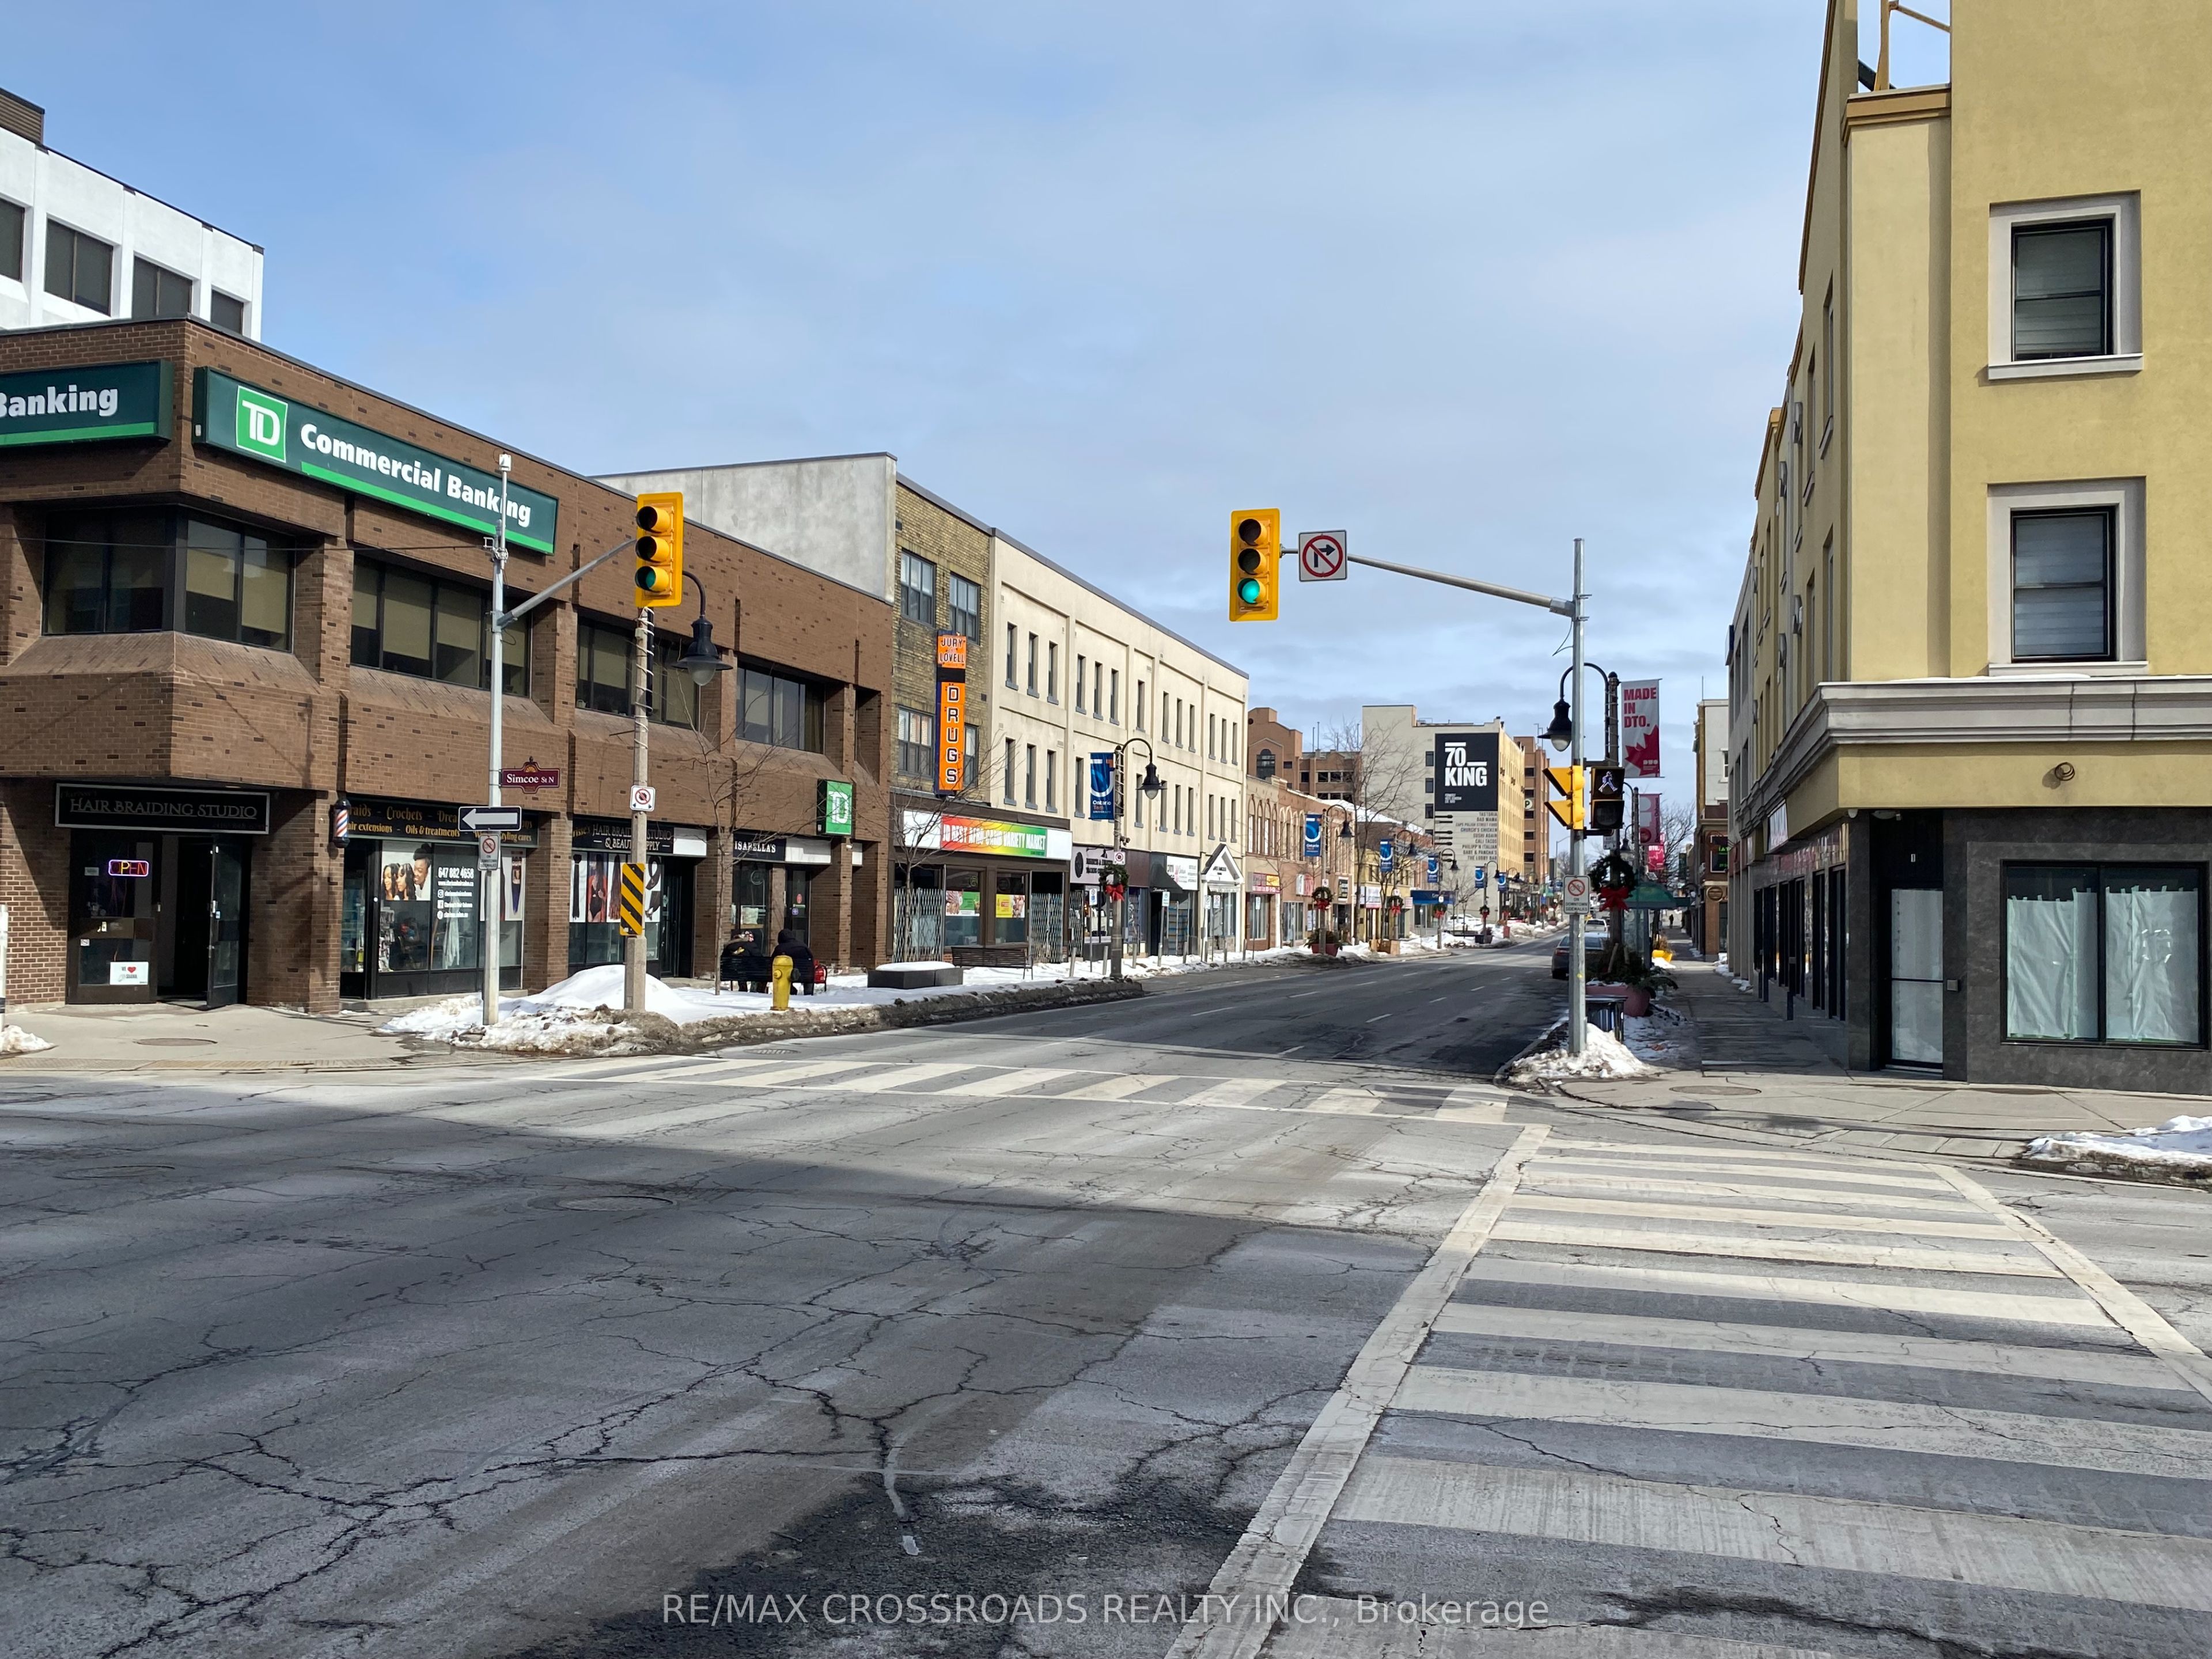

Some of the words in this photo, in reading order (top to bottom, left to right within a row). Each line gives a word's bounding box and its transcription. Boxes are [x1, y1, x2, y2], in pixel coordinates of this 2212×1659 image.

[242, 400, 281, 447] TD
[300, 423, 441, 493] Commercial
[941, 638, 963, 647] JURY
[940, 652, 964, 662] LOVELL
[1624, 687, 1657, 701] MADE
[1624, 702, 1635, 714] IN
[1624, 715, 1650, 728] DTO.
[946, 686, 959, 784] DRUGS
[1445, 747, 1466, 767] 70
[507, 774, 539, 783] Simcoe
[1445, 767, 1487, 787] KING
[70, 797, 111, 813] HAIR
[113, 801, 194, 816] BRAIDING
[196, 804, 257, 819] STUDIO
[348, 803, 372, 817] raids
[387, 806, 422, 820] Crochets
[347, 821, 357, 831] air
[358, 823, 392, 834] extensions
[406, 824, 418, 835] Oils
[419, 825, 425, 835] &
[425, 827, 460, 837] treatments
[592, 824, 611, 836] HAIR
[612, 839, 632, 849] BEAUT
[646, 842, 660, 851] PPLY
[734, 840, 776, 853] ISABELLA'S
[1003, 831, 1026, 849] VARIETY
[1025, 834, 1046, 850] MARKET
[438, 867, 449, 878] 647
[449, 868, 460, 878] 882
[460, 868, 474, 879] 4658
